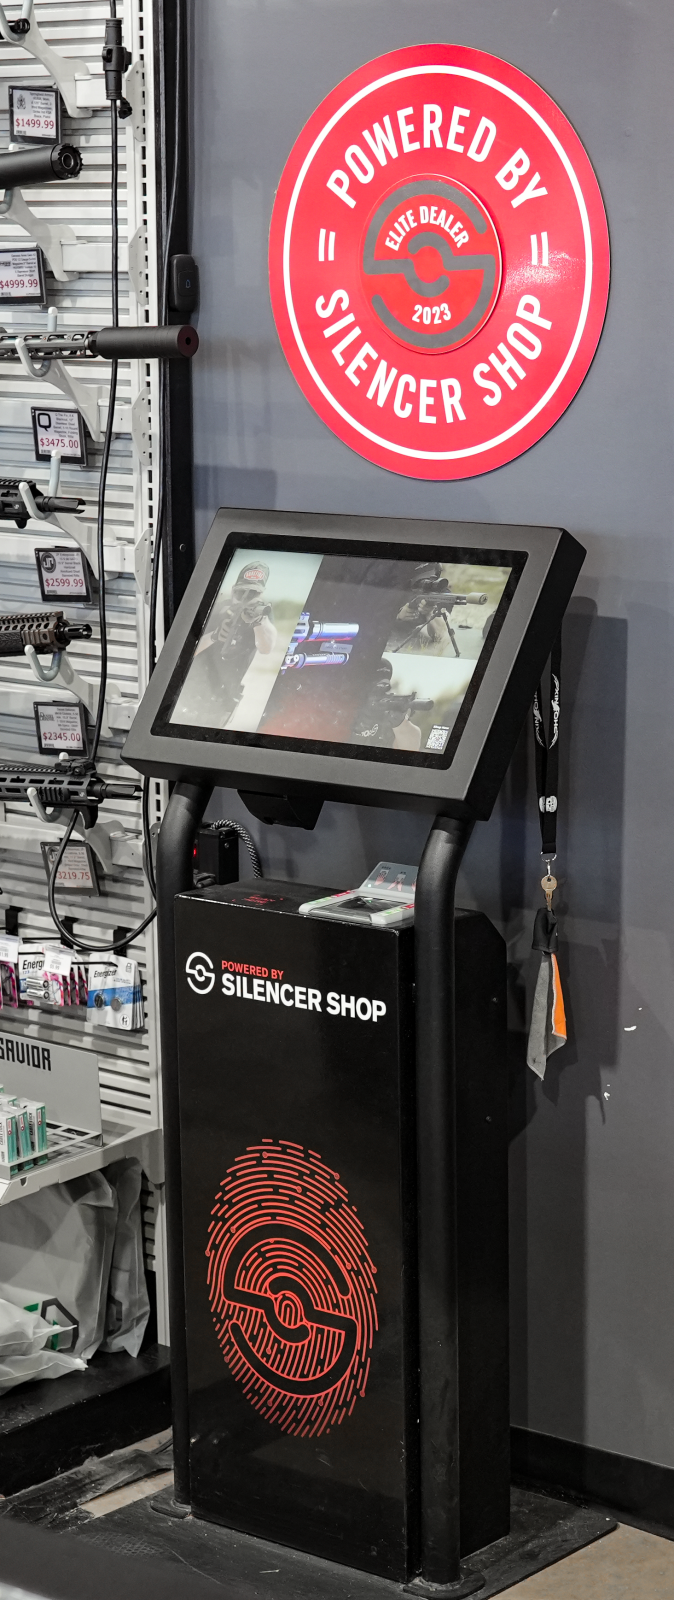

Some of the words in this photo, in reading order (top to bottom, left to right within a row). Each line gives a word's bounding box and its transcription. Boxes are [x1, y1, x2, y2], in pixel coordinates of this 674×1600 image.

[15, 117, 55, 130] $1499.99
[326, 103, 497, 209] POWERED
[495, 147, 548, 208] BY
[385, 208, 418, 252] ELITE
[419, 205, 470, 249] DEALER
[0, 278, 38, 290] $4999.99
[411, 303, 452, 325] 2023
[315, 289, 466, 425] SILENCER
[472, 294, 553, 407] SHOP
[39, 437, 79, 449] $3475.00
[45, 577, 84, 588] $2599.99
[42, 731, 81, 742] $2345.00
[57, 871, 91, 881] 3219.75
[23, 959, 45, 971] Energi
[221, 959, 269, 978] POWERED
[271, 968, 284, 980] BY
[93, 969, 118, 979] Energizer
[221, 973, 322, 1013] SILENCER
[326, 992, 387, 1023] SHOP
[0, 1037, 52, 1072] SAVIOR
